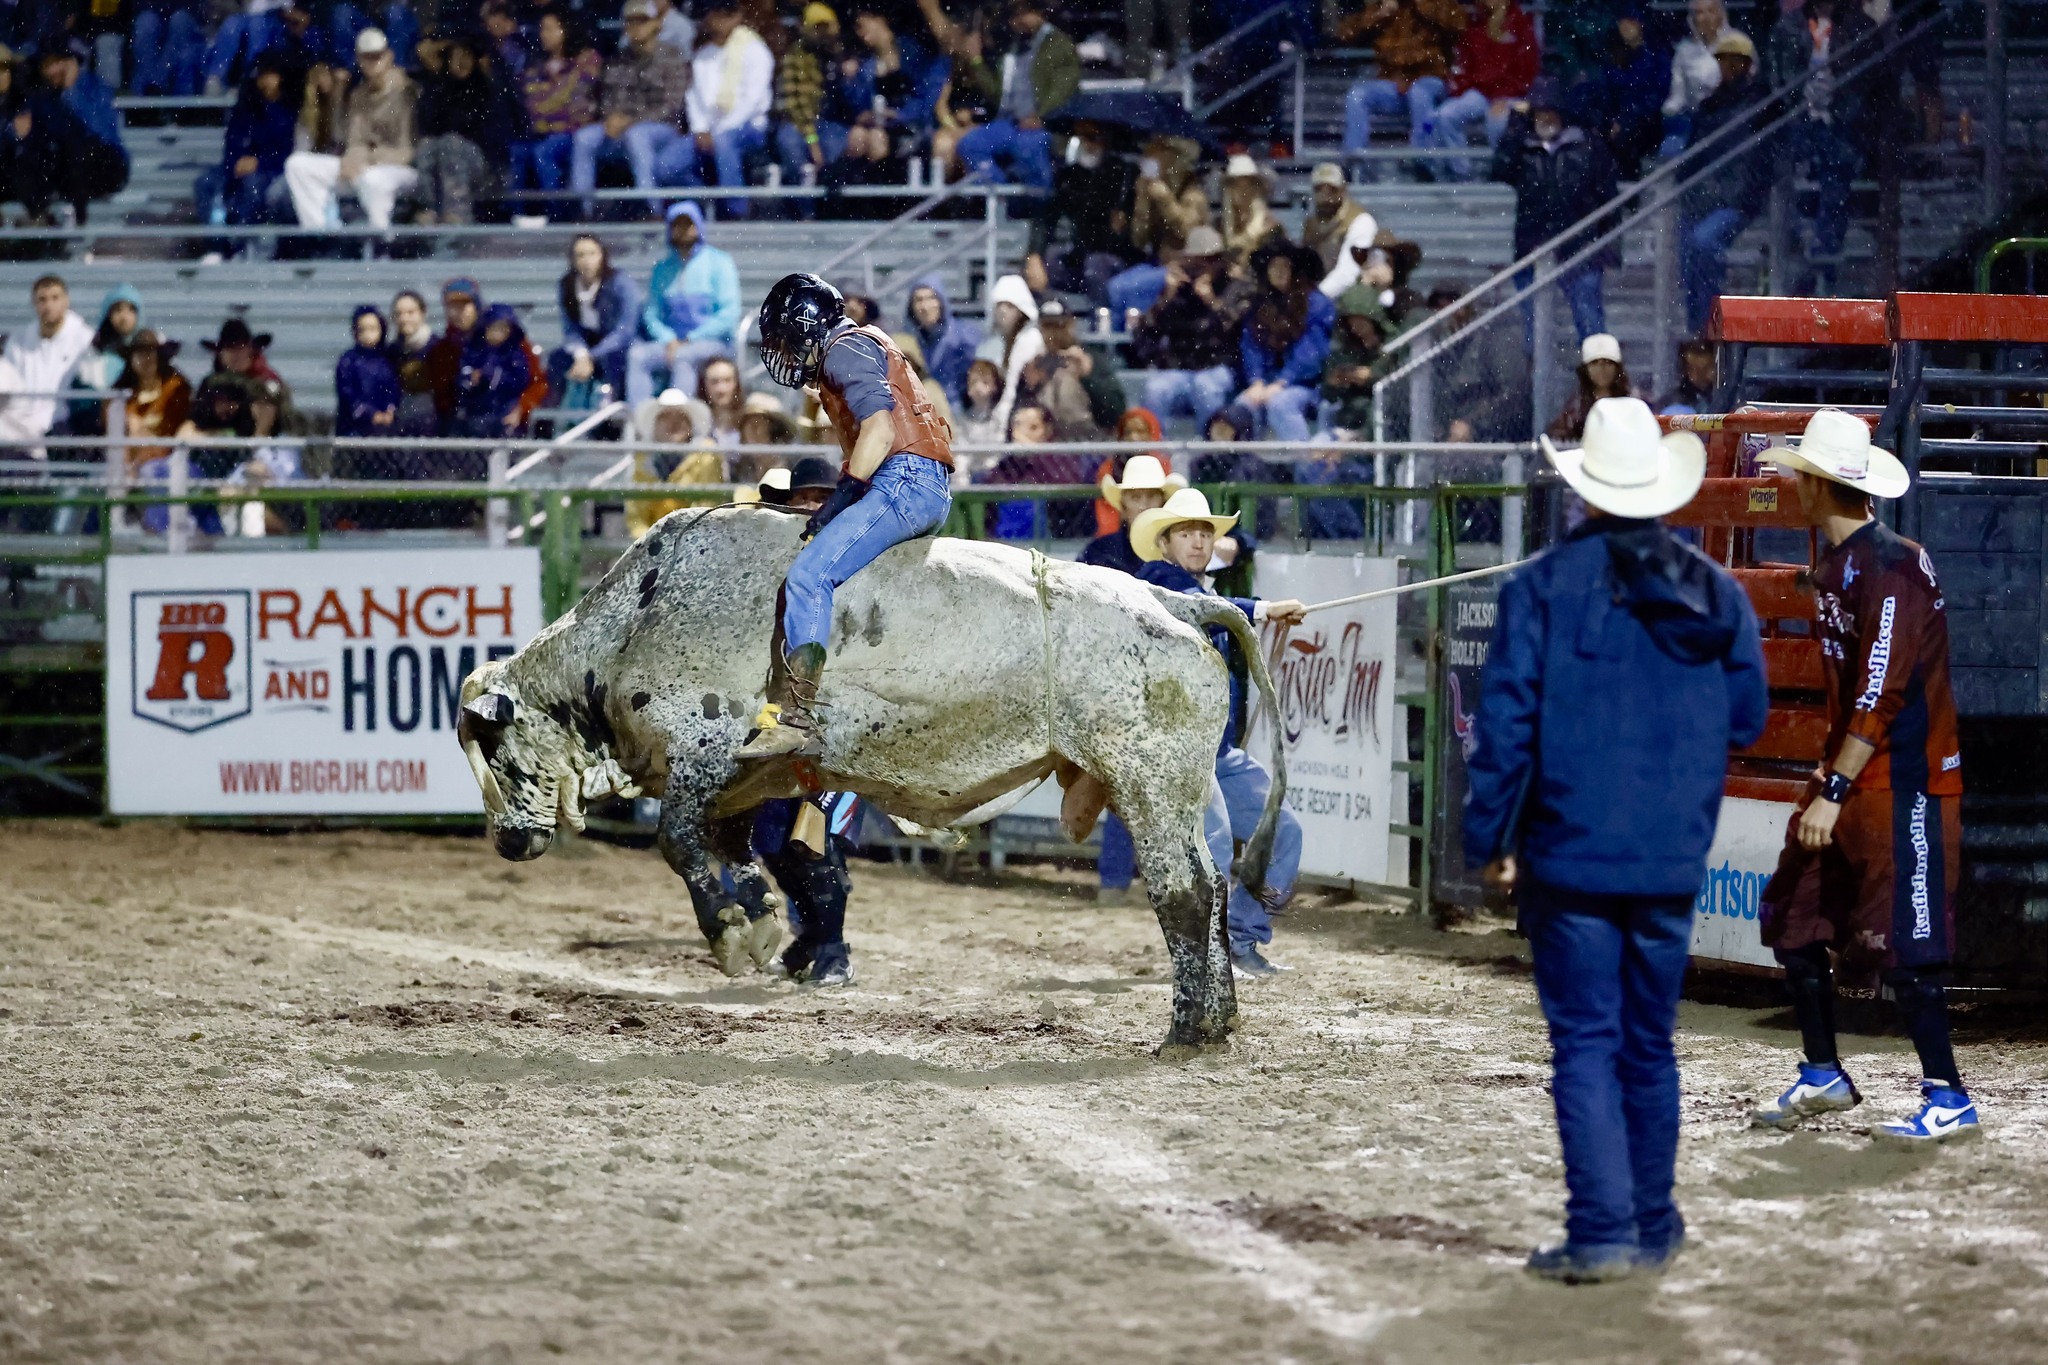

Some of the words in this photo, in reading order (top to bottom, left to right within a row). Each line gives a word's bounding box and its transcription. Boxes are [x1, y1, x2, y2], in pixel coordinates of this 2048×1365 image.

[1890, 341, 1898, 389] 2
[1750, 489, 1776, 510] Wrangler
[257, 586, 513, 640] RANCH
[145, 631, 235, 700] R
[1450, 641, 1476, 666] HOLE
[264, 669, 330, 700] AND
[342, 644, 518, 731] HOM
[219, 759, 427, 794] WWW.BIGRJH.COM
